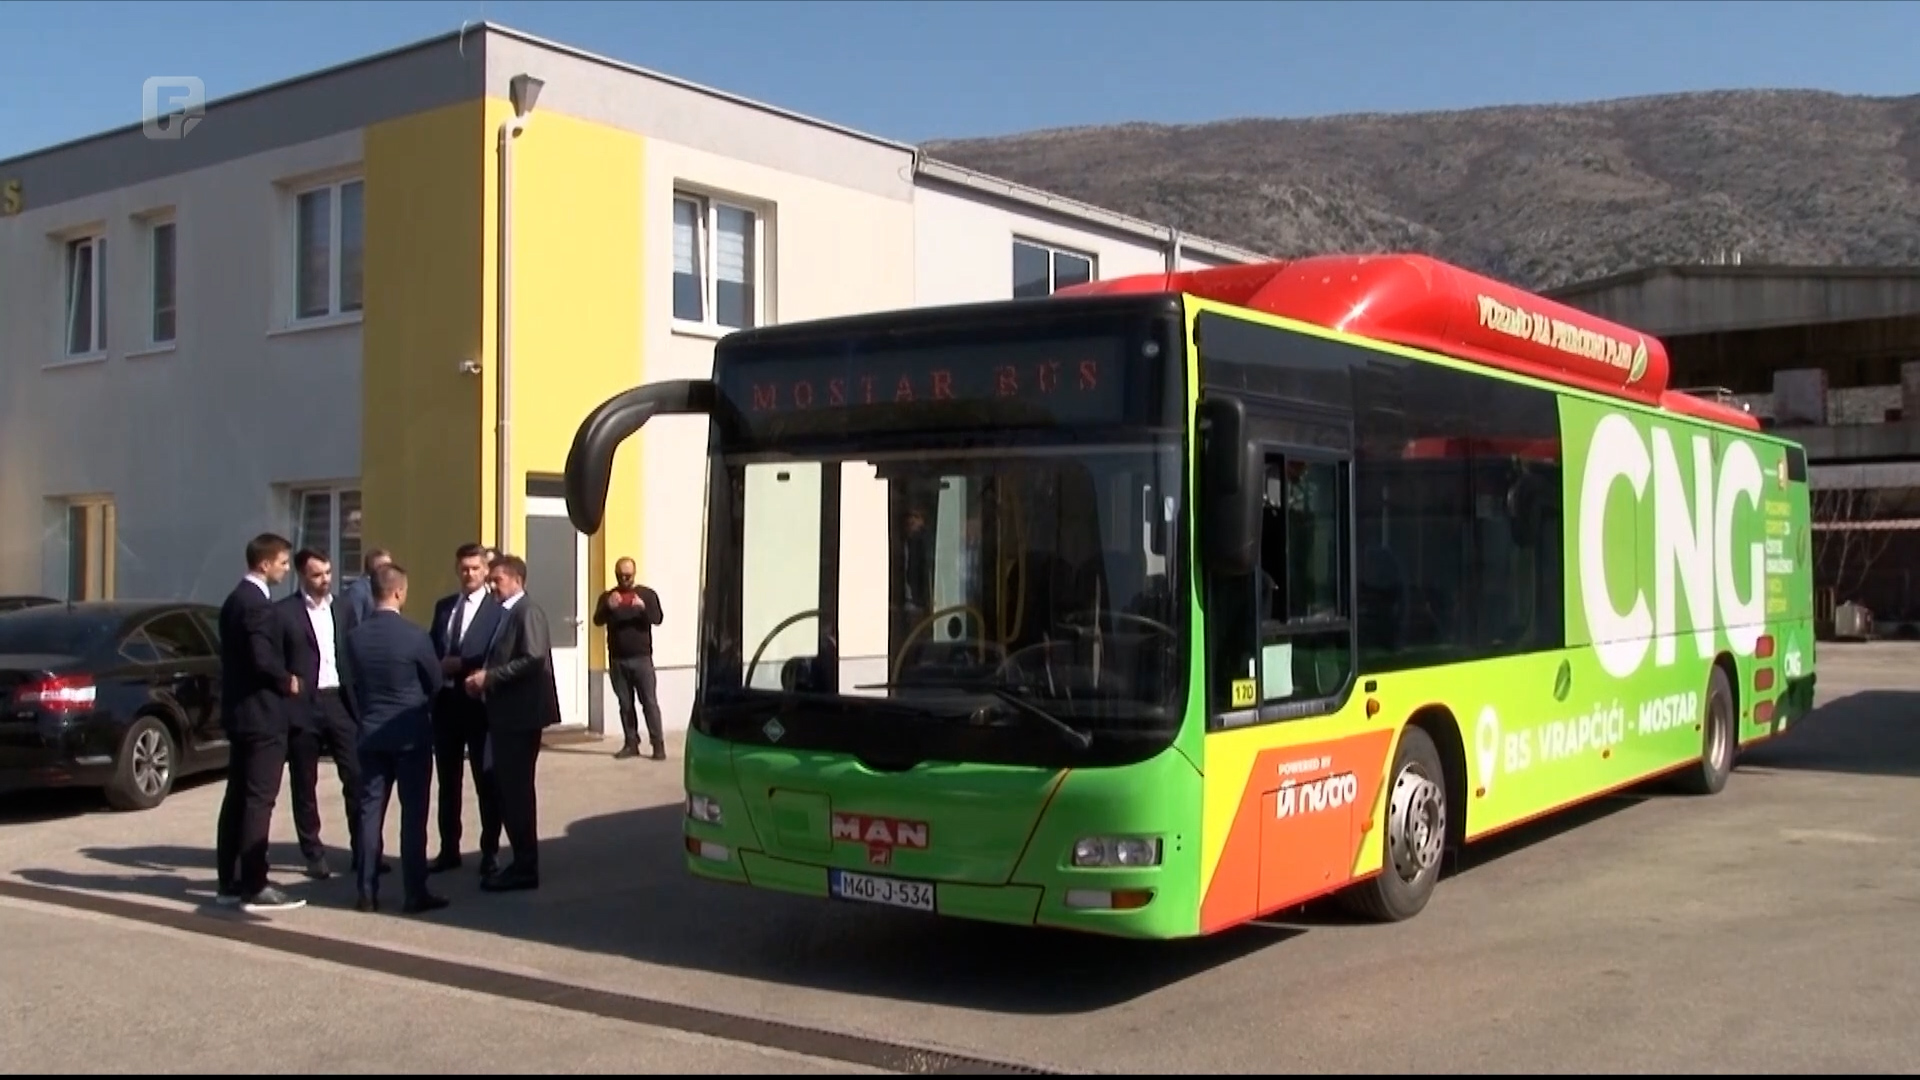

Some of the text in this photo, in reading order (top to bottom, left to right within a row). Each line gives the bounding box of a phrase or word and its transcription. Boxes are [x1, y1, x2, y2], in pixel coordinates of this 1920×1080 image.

[1532, 312, 1551, 346] NA
[752, 359, 1098, 411] MOSTAR BUS
[1579, 413, 1766, 678] CNG
[1235, 684, 1254, 700] 170
[1504, 730, 1532, 773] BS
[1538, 699, 1624, 763] VRAPČIĆI
[1638, 691, 1698, 736] MOSTAR
[1278, 756, 1332, 775] POWERED BY
[832, 815, 927, 848] MAN
[843, 875, 931, 907] M40-J-534
